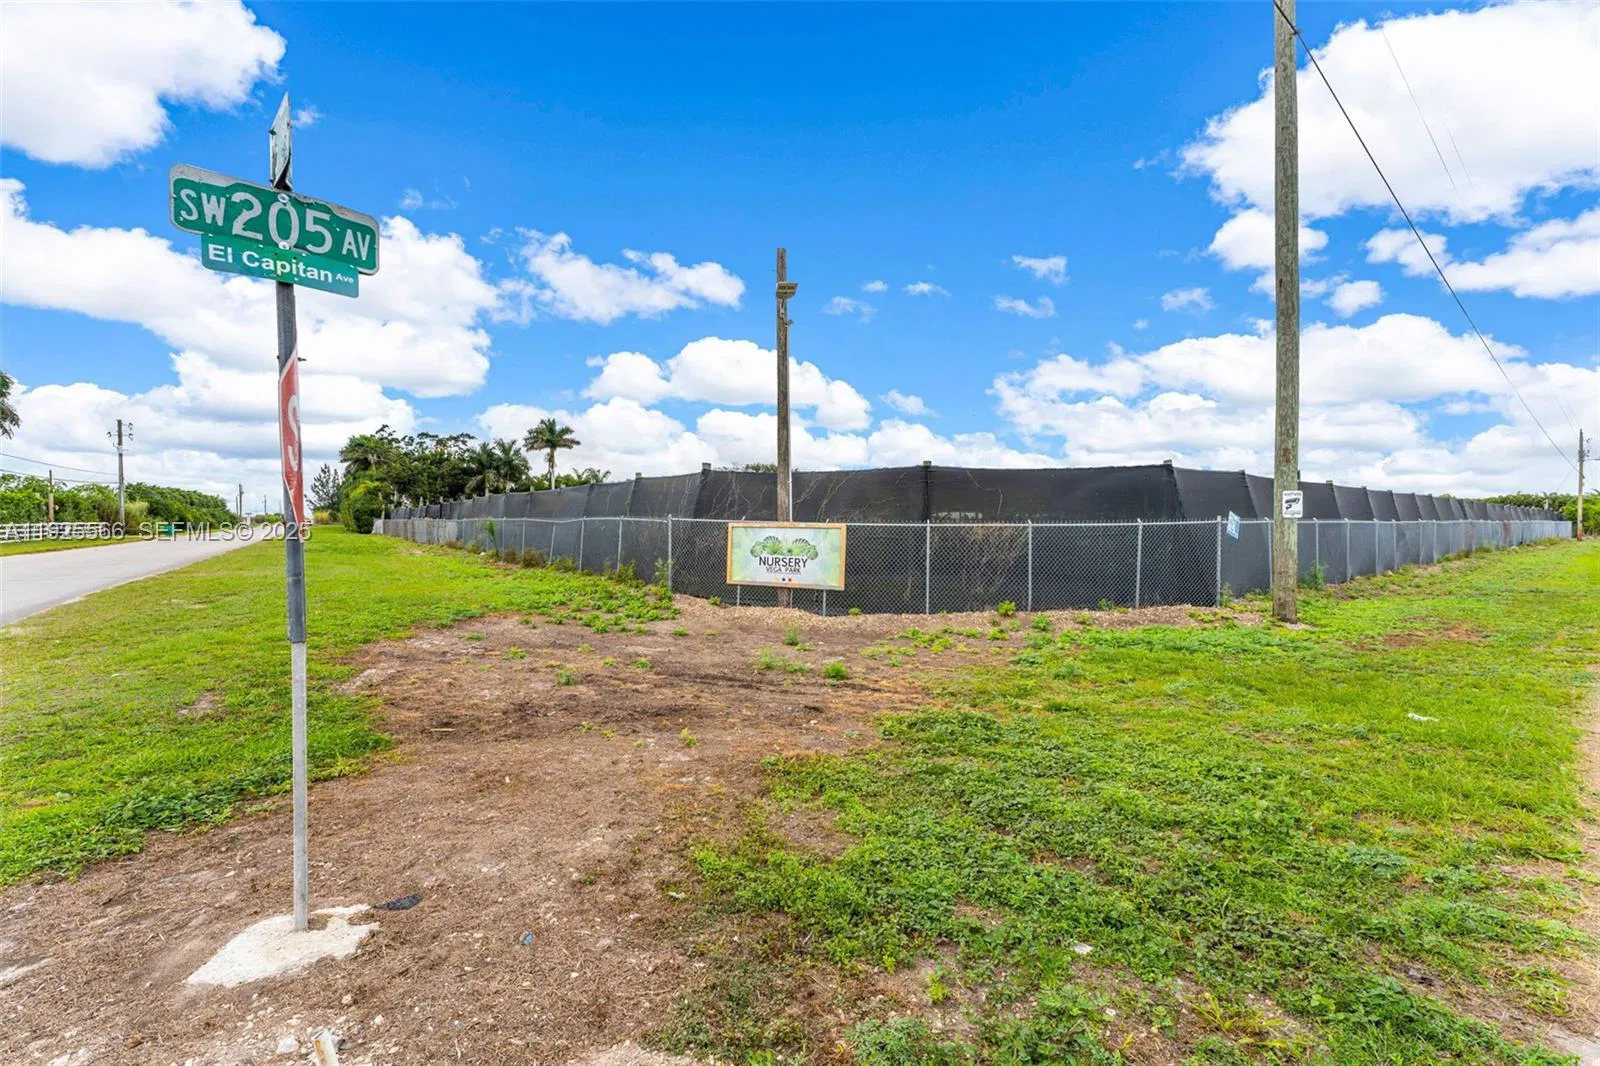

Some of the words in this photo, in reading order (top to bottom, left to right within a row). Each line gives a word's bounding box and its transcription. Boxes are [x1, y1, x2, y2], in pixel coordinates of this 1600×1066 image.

[179, 188, 226, 227] SW
[231, 191, 333, 254] 205
[341, 228, 371, 261] AV
[207, 243, 233, 264] El
[241, 250, 333, 284] Capitan
[335, 272, 354, 284] Ave
[759, 556, 808, 569] NURSERY
[785, 567, 801, 575] PARK
